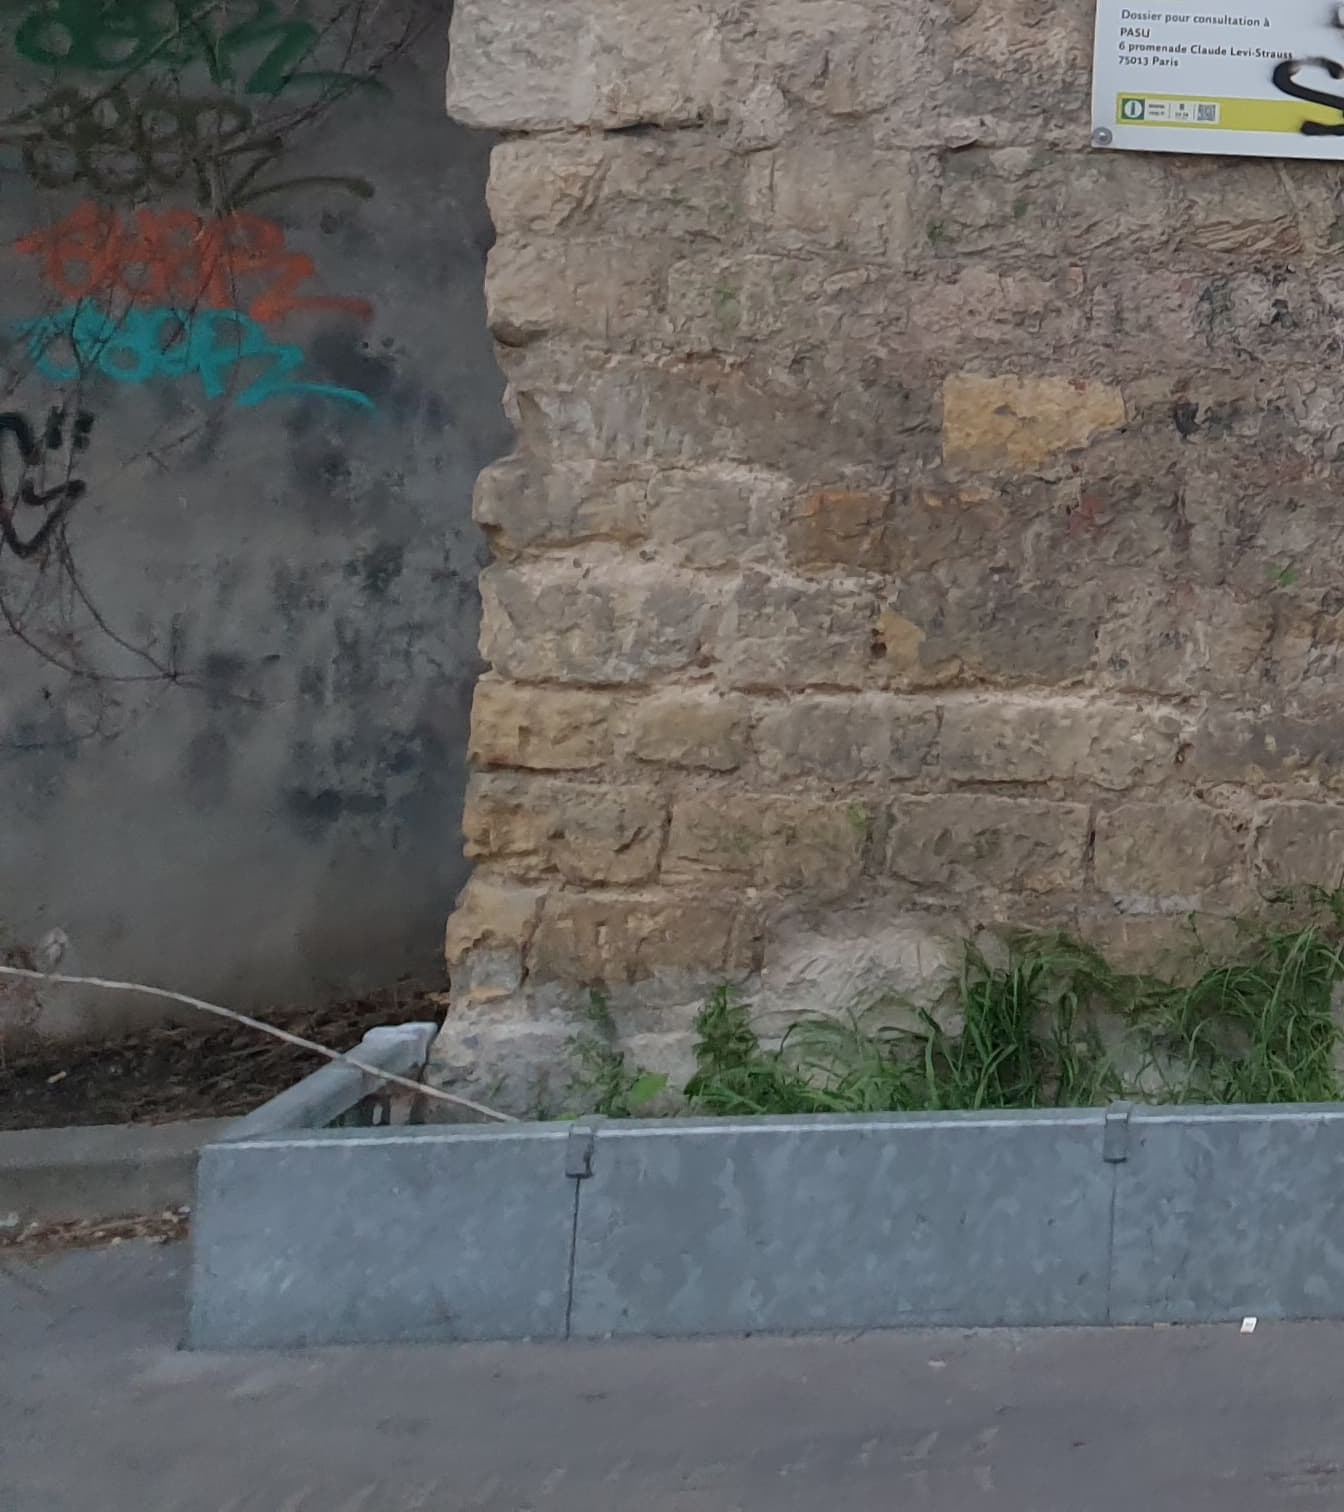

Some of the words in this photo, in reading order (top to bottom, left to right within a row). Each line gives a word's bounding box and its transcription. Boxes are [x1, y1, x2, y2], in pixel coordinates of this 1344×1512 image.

[1121, 9, 1162, 21] Dossier
[1165, 12, 1190, 24] pour
[1193, 14, 1260, 27] consultation
[1263, 17, 1270, 27] à
[1118, 42, 1126, 51] 6
[1128, 41, 1187, 54] promenade
[1190, 44, 1227, 56] Claude
[1230, 46, 1293, 60] Levi-Strauss
[1118, 55, 1149, 66] 75013
[1152, 56, 1179, 68] Paris
